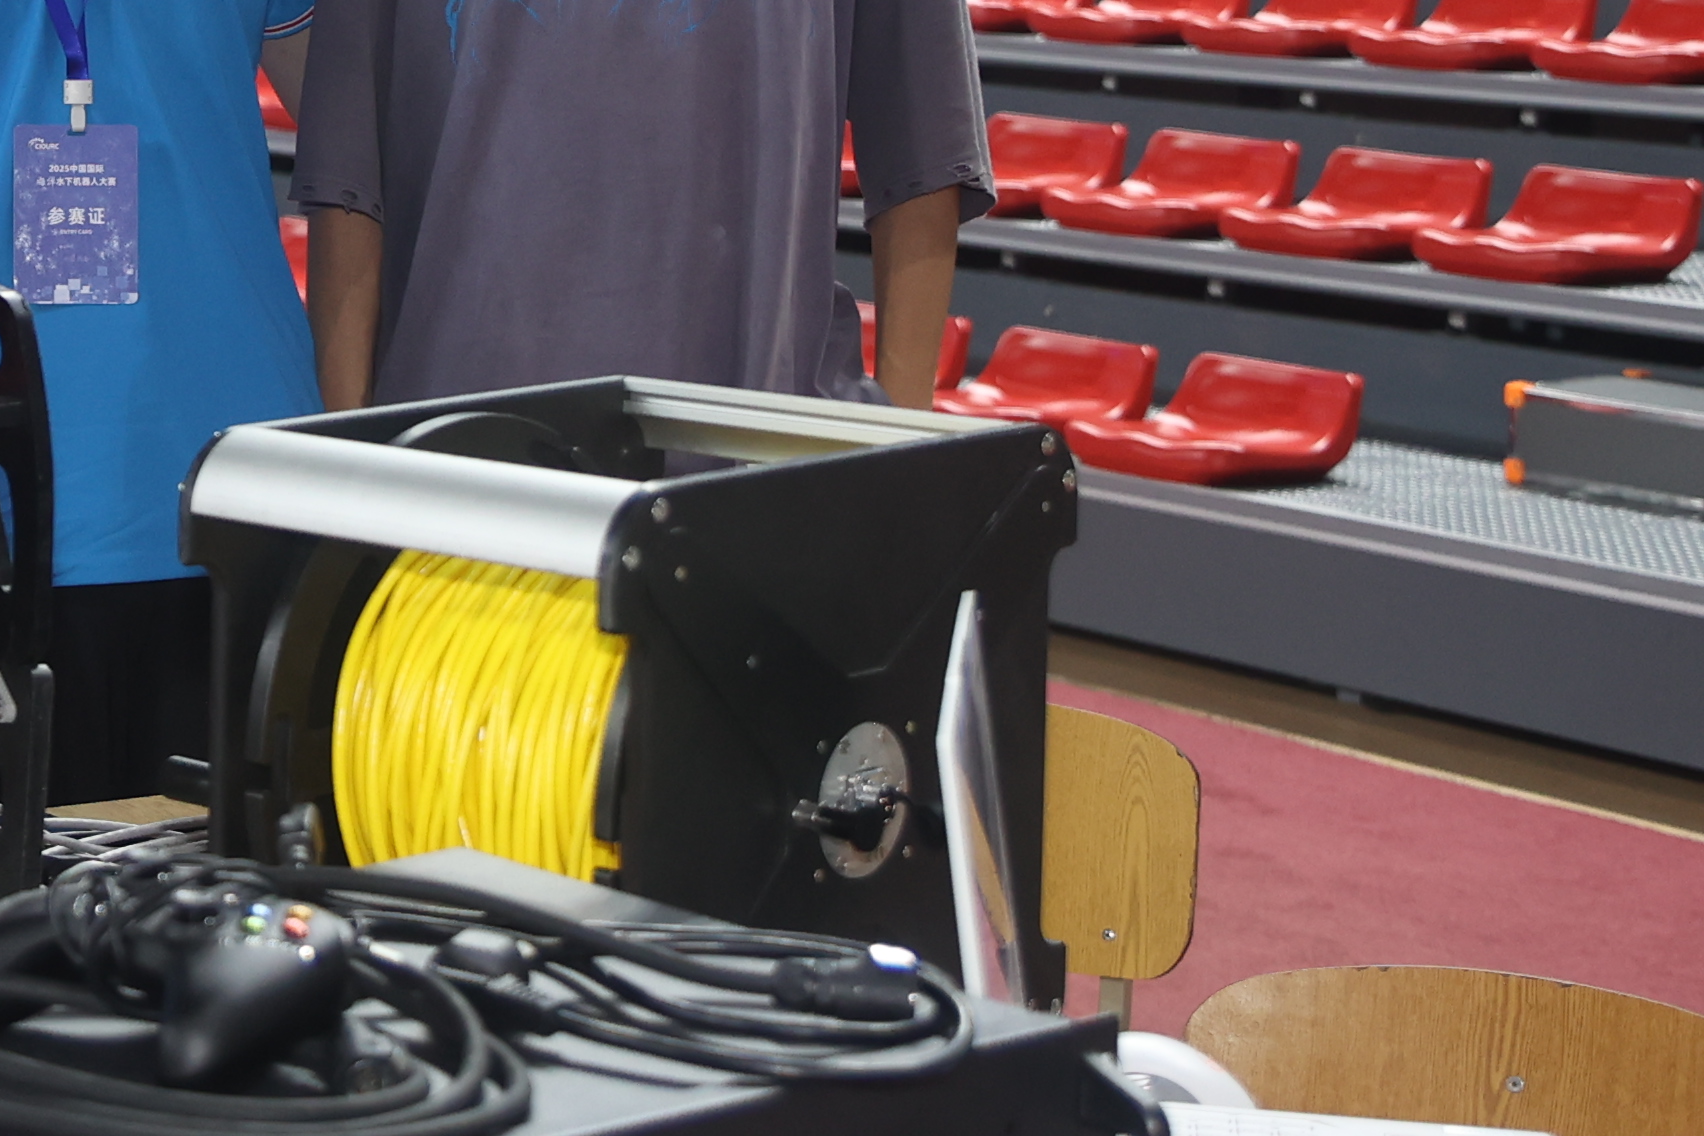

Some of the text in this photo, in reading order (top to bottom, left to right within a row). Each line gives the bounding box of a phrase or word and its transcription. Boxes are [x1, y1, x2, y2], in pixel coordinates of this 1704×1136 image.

[49, 164, 104, 173] 2025中国国际
[37, 177, 116, 186] 海洋水下机器人大赛
[47, 206, 106, 225] 参赛证
